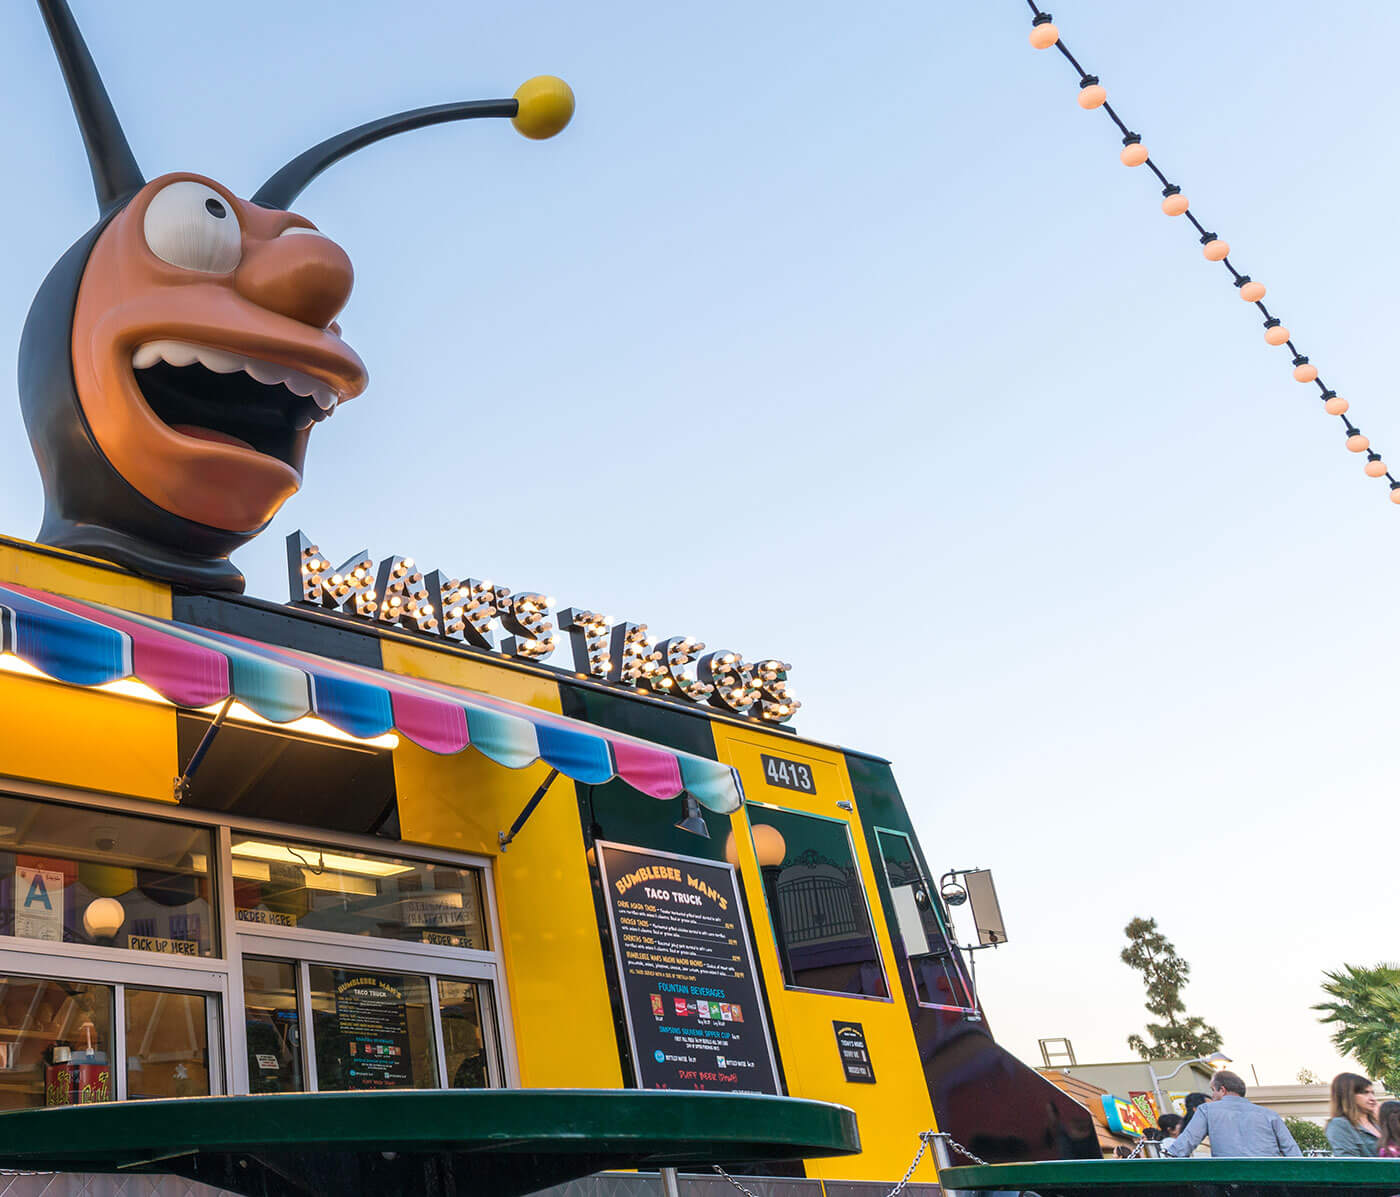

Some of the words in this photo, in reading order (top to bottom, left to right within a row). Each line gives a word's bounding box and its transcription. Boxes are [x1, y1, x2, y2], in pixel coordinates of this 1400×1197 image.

[286, 529, 560, 661] MAN'S
[557, 607, 801, 723] TACOS
[767, 759, 812, 790] 4413
[24, 874, 53, 910] A
[615, 865, 682, 895] BUMBLEBEE
[686, 873, 729, 911] MAN'S
[644, 887, 670, 901] TACO
[671, 891, 703, 906] TRUCK
[238, 910, 266, 924] ORDER
[269, 913, 292, 927] HERE
[131, 937, 152, 952] PICK
[155, 939, 168, 953] UP
[171, 942, 196, 955] HERE
[427, 933, 451, 946] ORDER
[354, 989, 369, 997] TACO
[370, 990, 387, 998] TRUCK
[658, 982, 689, 994] FOUNTAIN
[690, 986, 726, 998] BEVERAGES
